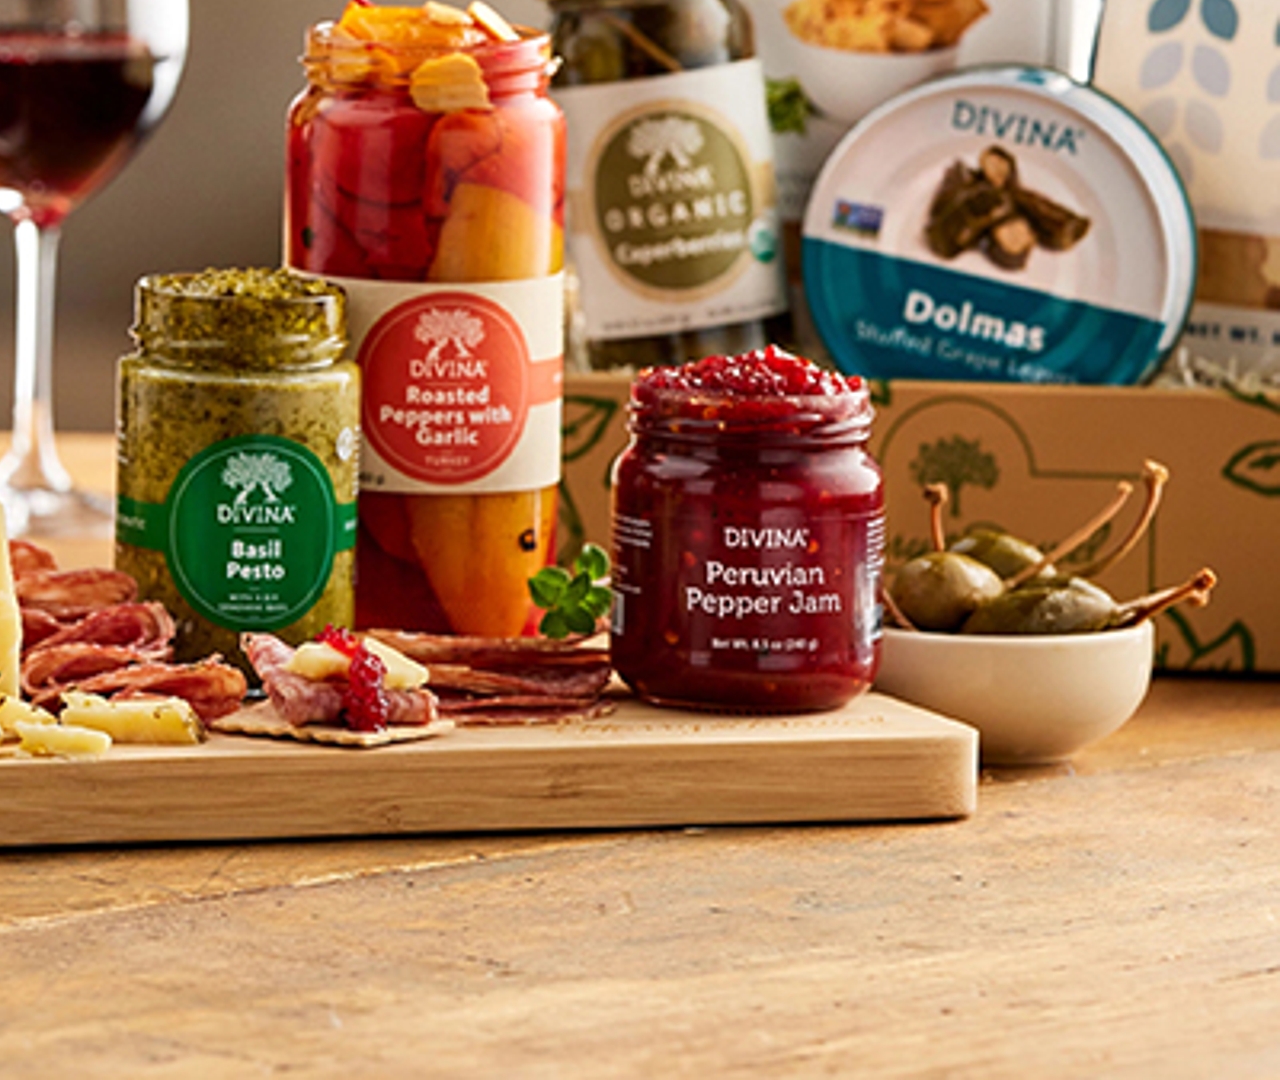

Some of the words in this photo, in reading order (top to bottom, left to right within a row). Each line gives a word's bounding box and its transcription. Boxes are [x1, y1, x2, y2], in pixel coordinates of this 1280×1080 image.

[951, 99, 1080, 156] DIVINA
[903, 289, 1047, 352] Dolmas
[409, 360, 487, 377] DIVINA
[405, 385, 490, 404] Roasted
[380, 406, 465, 429] Peppers
[469, 405, 513, 424] with
[415, 426, 479, 446] Garlic
[216, 504, 295, 525] DIVINA
[724, 526, 808, 549] DIVINA
[230, 539, 282, 559] Basil
[226, 561, 286, 580] Pesto
[705, 561, 825, 586] Peruvian
[685, 587, 782, 619] Pepper
[789, 589, 842, 614] Jam
